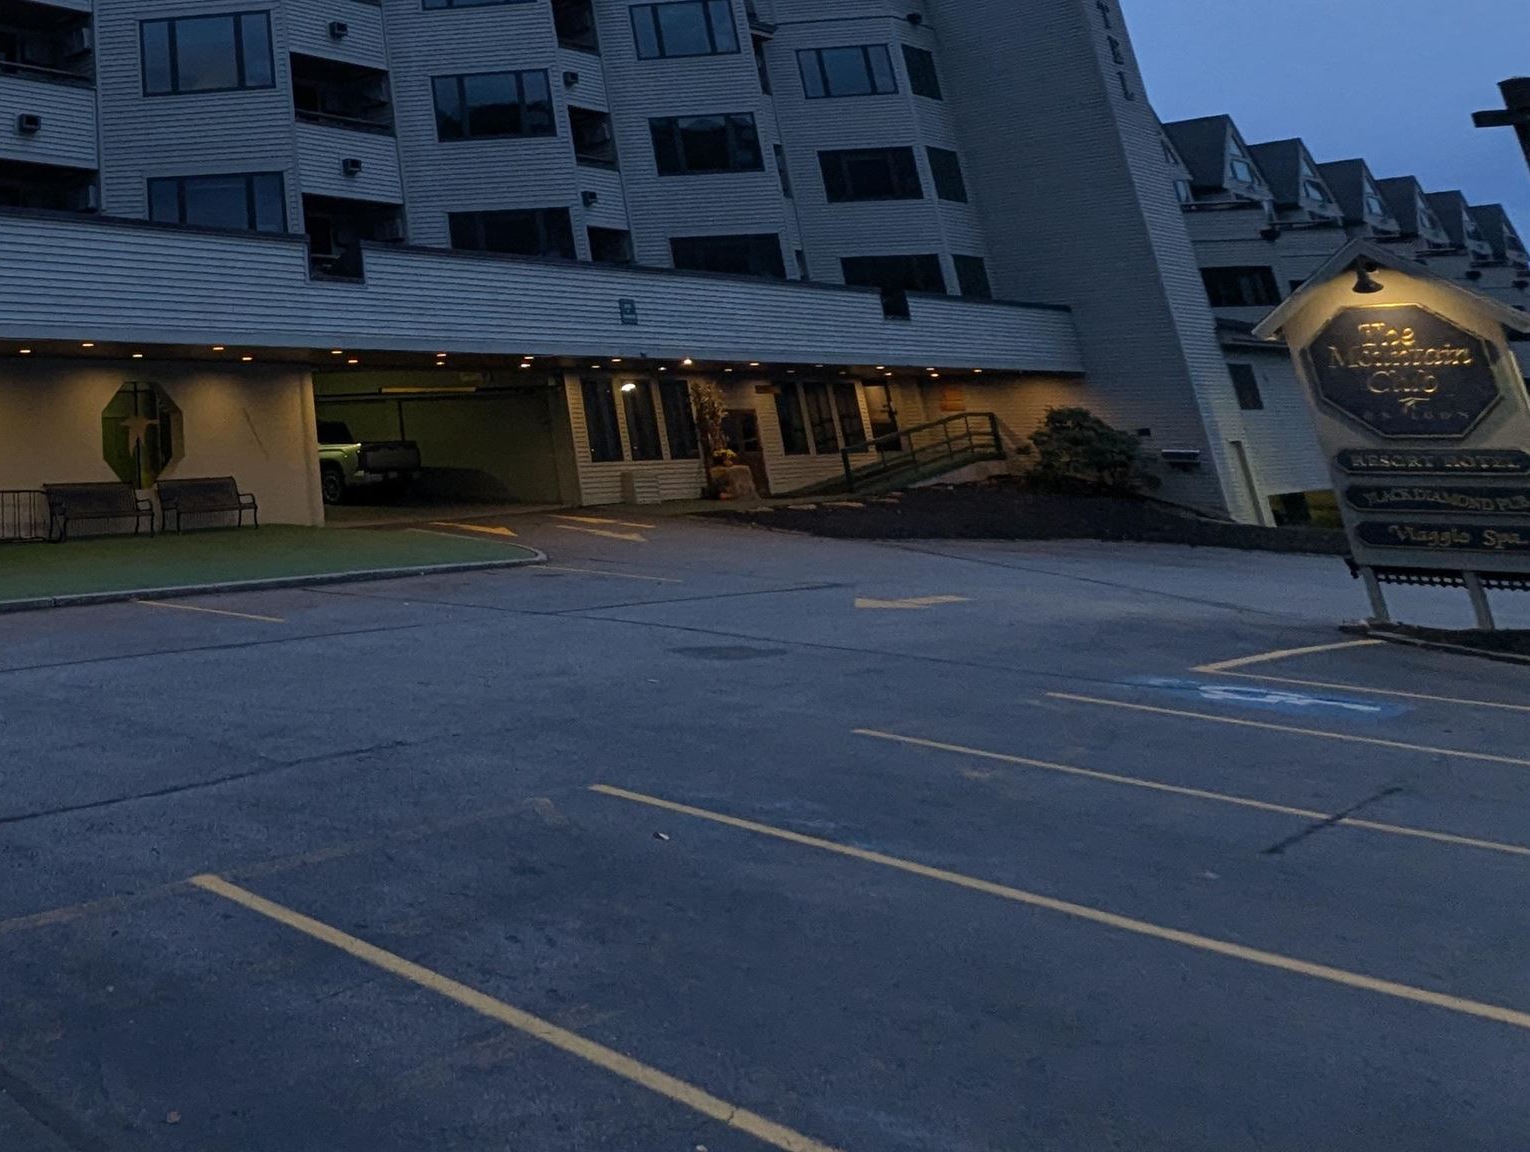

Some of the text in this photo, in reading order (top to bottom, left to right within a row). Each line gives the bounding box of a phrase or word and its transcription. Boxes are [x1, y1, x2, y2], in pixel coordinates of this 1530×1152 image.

[1357, 322, 1416, 347] The
[1351, 454, 1521, 469] RESORT HOTEL
